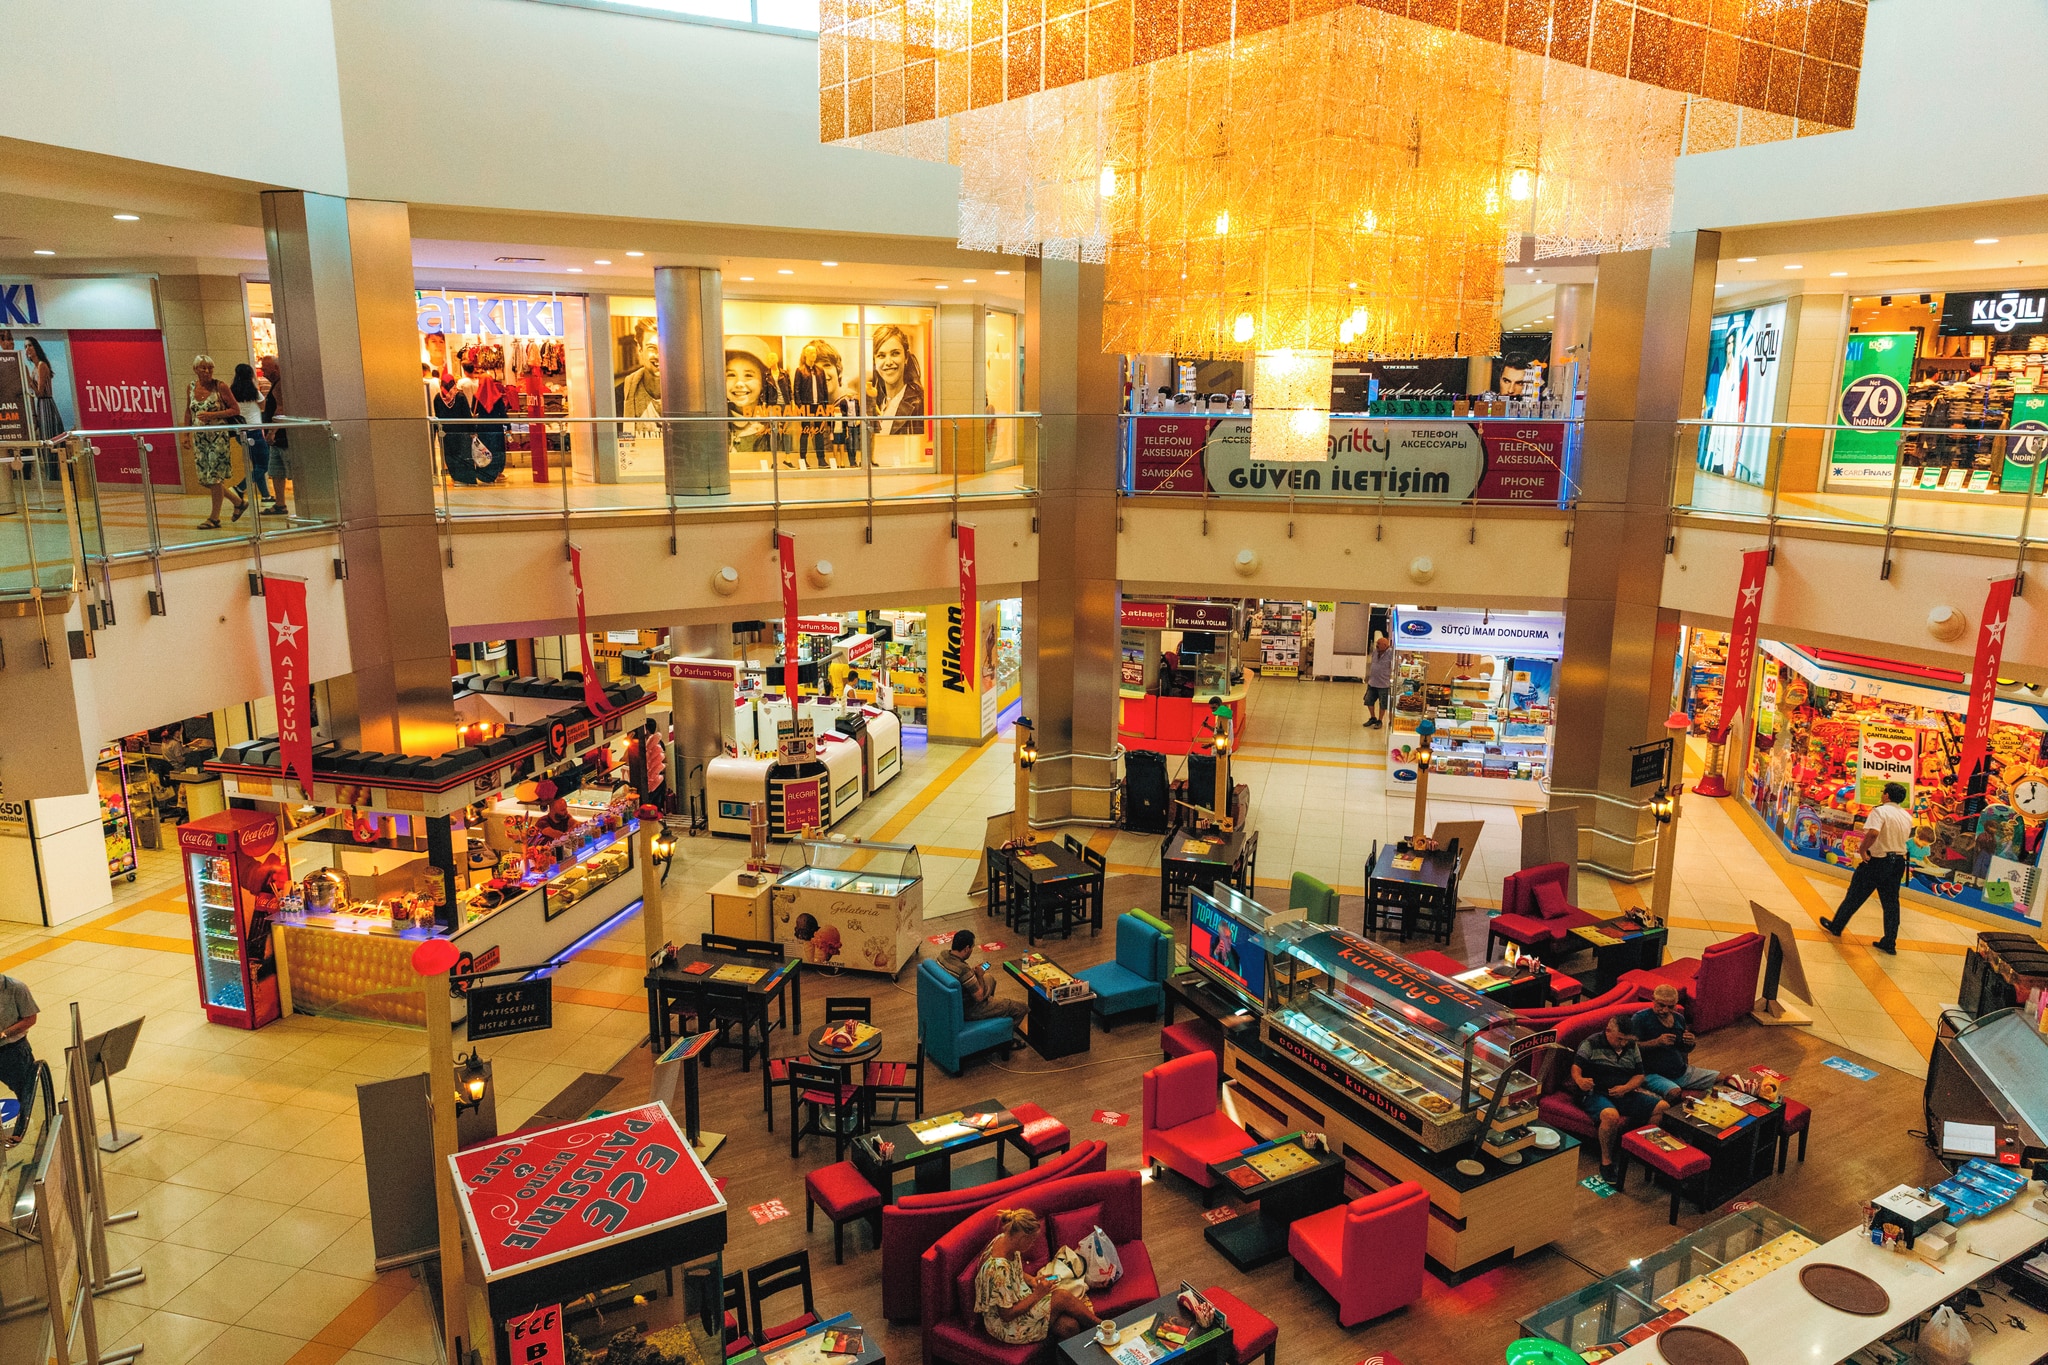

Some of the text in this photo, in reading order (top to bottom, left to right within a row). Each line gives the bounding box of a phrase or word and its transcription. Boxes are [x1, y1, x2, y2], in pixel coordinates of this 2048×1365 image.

[86, 380, 167, 413] İNDİRİM
[1850, 386, 1897, 417] 70
[1853, 417, 1886, 426] İNDİRİM
[1159, 425, 1178, 433] CEP
[1411, 430, 1458, 438] ТЕЛЕФОН
[1516, 430, 1538, 439] CEP
[1144, 437, 1192, 445] TELEFONU
[1401, 440, 1467, 449] АКСЕССУАРЫ
[1499, 442, 1553, 452] TELEFONU
[1142, 448, 1193, 457] AKSESUARI
[1496, 455, 1553, 465] AKSESUARI
[1141, 469, 1193, 478] SAMSUNG
[1228, 463, 1320, 490] GÜVEN
[1160, 480, 1174, 489] LG
[1501, 477, 1545, 486] IPHONE
[1510, 489, 1533, 499] HTC
[1128, 610, 1164, 619] atlasjet
[1319, 604, 1328, 612] 300
[798, 622, 838, 633] Parfum Shop
[1441, 624, 1549, 639] SÜTÇÜ İMAM DONDURMA
[942, 605, 965, 693] Nikon
[684, 667, 732, 679] Parfum Shop
[1866, 733, 1913, 741] ÇANTALARINDA
[1863, 742, 1913, 761] %30
[1863, 758, 1911, 774] İNDİRİM
[830, 901, 880, 917] Gelateria
[1337, 948, 1441, 1005] kurabiye
[1342, 935, 1482, 1007] cookies bar
[496, 991, 522, 1003] ECE
[479, 1020, 507, 1030] BISTRO
[518, 1016, 539, 1024] CAFE
[1511, 1035, 1554, 1054] cookies
[1279, 1037, 1327, 1071] cookies
[1346, 1075, 1407, 1120] kurabiye
[471, 1147, 522, 1185] CAFE
[513, 1163, 535, 1178] &
[516, 1151, 577, 1199] BISTRO
[501, 1118, 655, 1250] PATISSERIE
[582, 1143, 680, 1233] ECE
[1206, 1206, 1230, 1221] ECE
[514, 1311, 557, 1340] ECE
